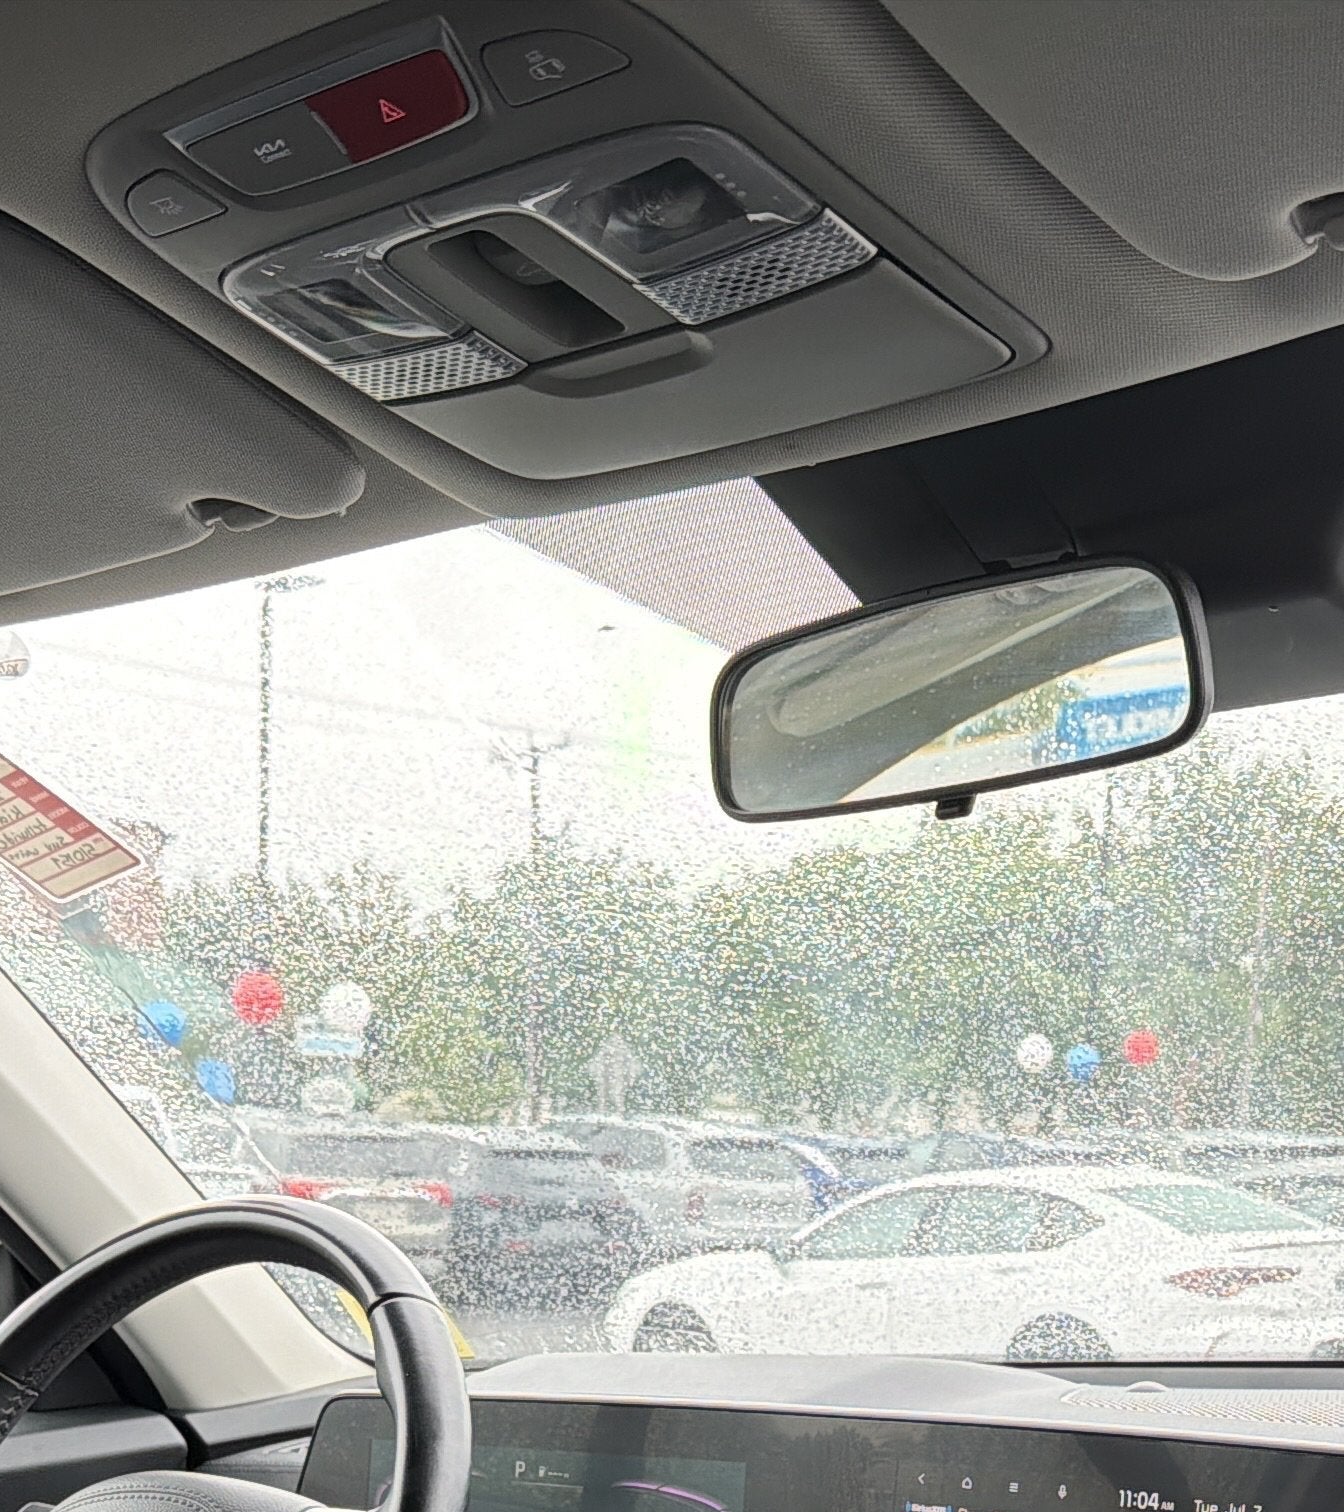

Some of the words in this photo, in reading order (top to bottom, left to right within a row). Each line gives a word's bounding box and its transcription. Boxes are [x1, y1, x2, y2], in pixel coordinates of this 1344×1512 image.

[515, 1461, 526, 1478] P
[1119, 1489, 1160, 1511] 11:04
[1160, 1501, 1175, 1512] AM
